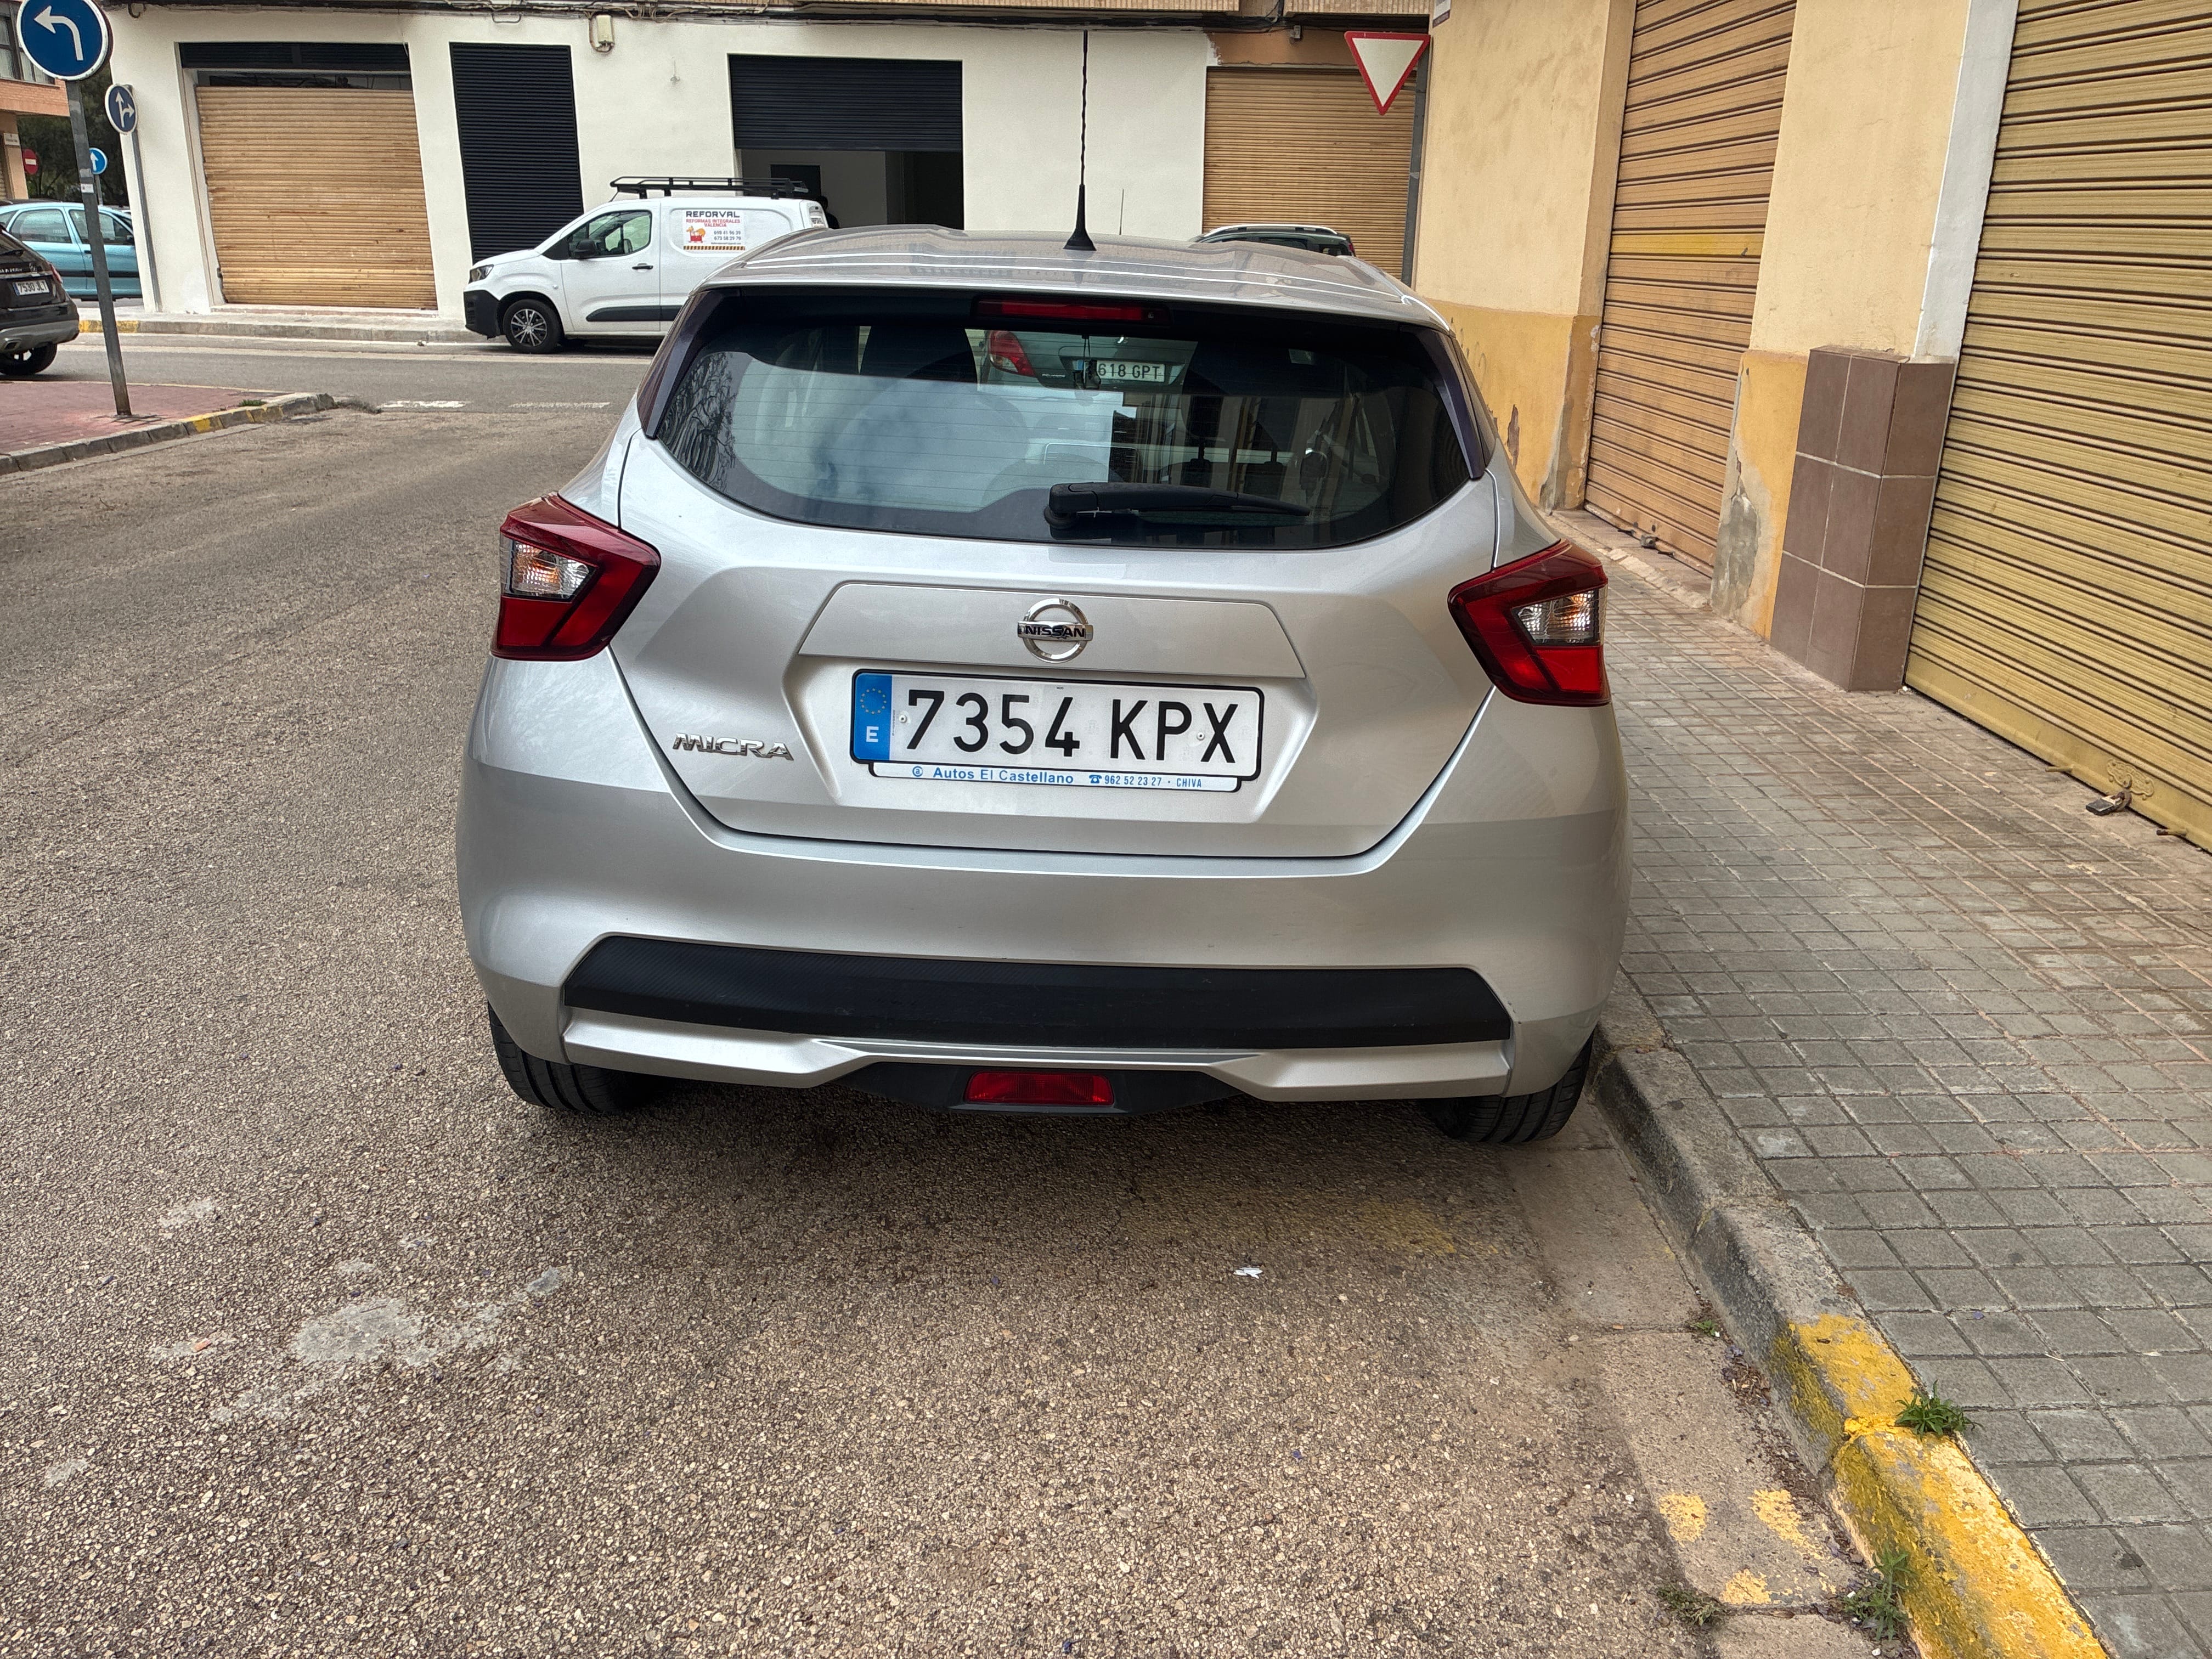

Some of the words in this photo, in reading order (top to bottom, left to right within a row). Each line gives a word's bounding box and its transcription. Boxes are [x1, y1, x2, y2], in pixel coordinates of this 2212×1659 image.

[1132, 364, 1160, 380] GPT
[1025, 625, 1085, 637] NISSAN
[866, 726, 879, 743] E
[906, 689, 1080, 757] 7354
[1110, 698, 1239, 764] KPX
[672, 732, 794, 761] MICRA
[933, 767, 975, 780] Autos
[980, 769, 994, 781] El
[999, 770, 1074, 784] Castellano
[1104, 775, 1121, 785] 962
[1124, 775, 1135, 786] 52
[1137, 776, 1148, 786] 23
[1152, 777, 1162, 786] 27
[1176, 777, 1202, 788] CHIVA
